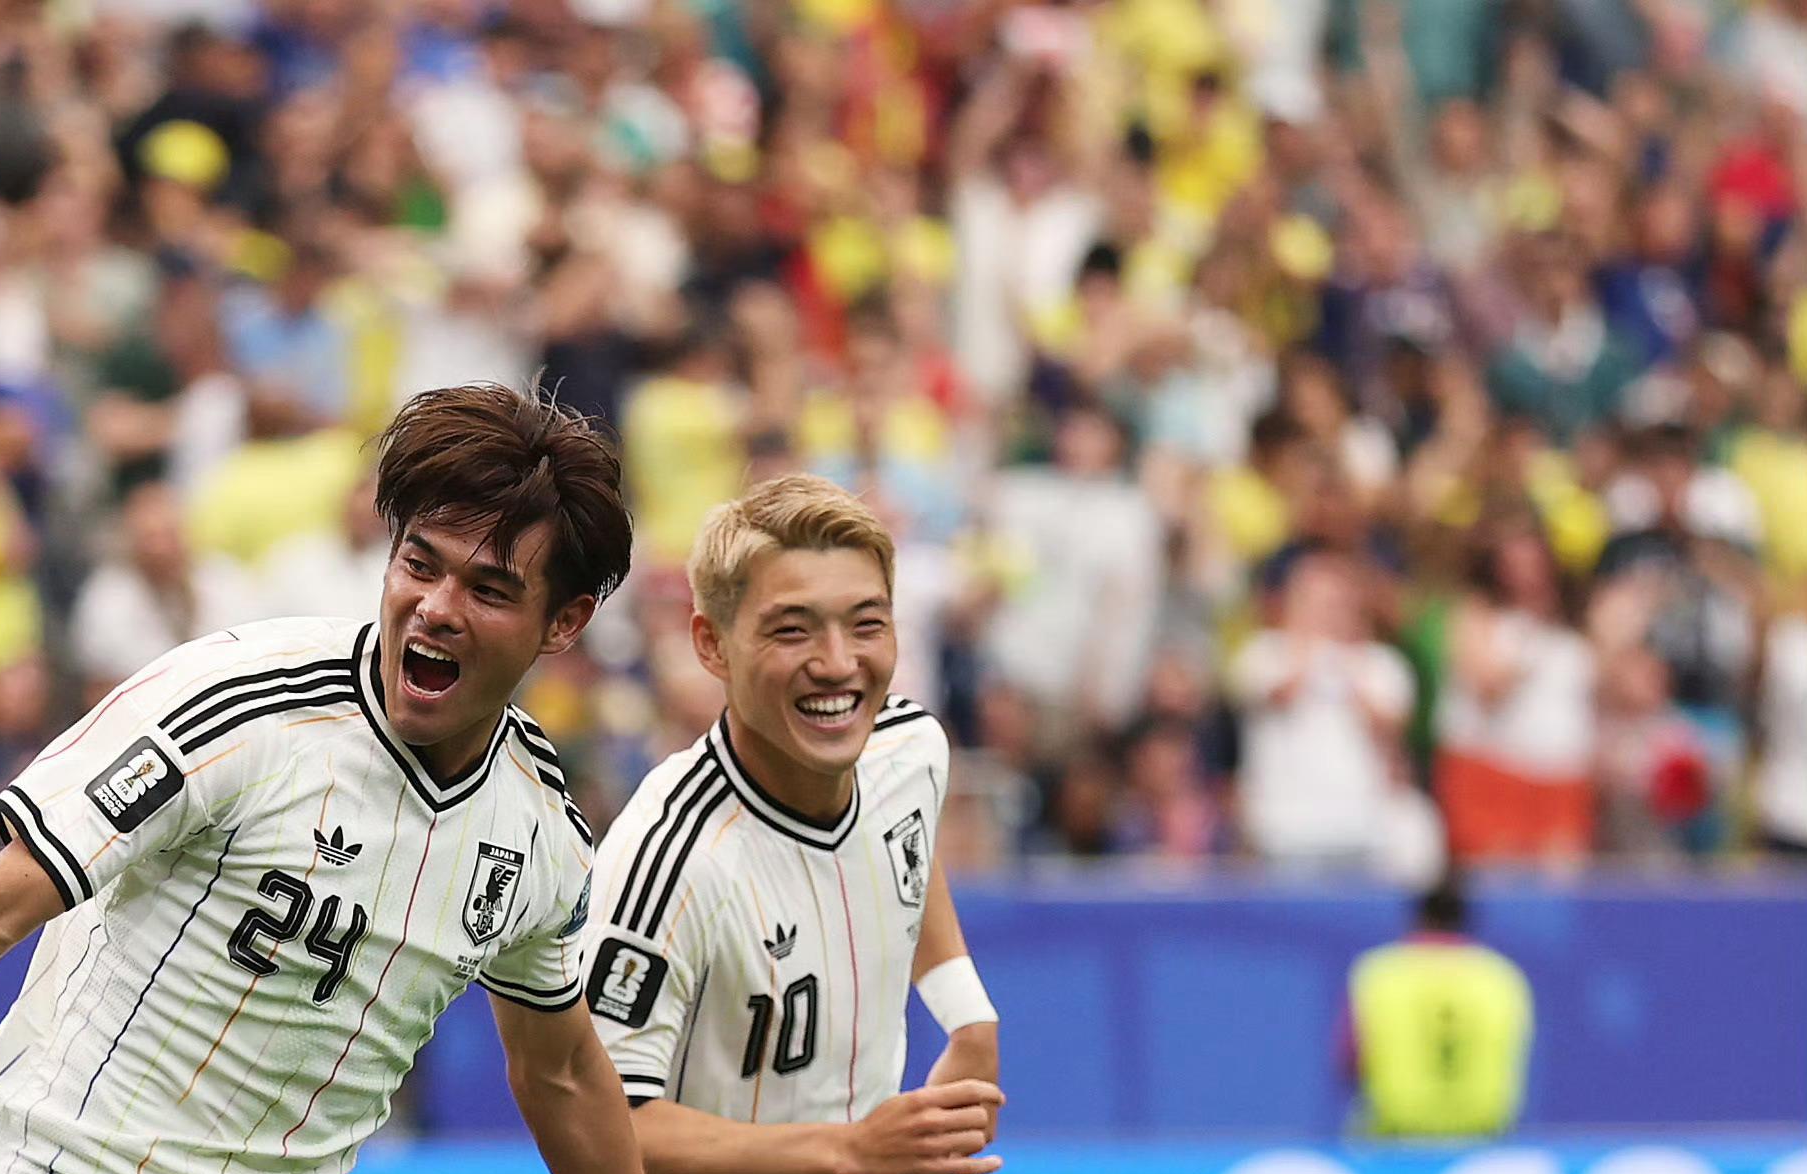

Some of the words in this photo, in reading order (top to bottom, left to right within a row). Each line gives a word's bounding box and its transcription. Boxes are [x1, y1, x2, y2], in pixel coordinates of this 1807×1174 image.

[93, 787, 121, 818] 2026
[490, 847, 516, 861] JAPAN
[227, 869, 370, 1006] 24
[741, 973, 817, 1079] 10
